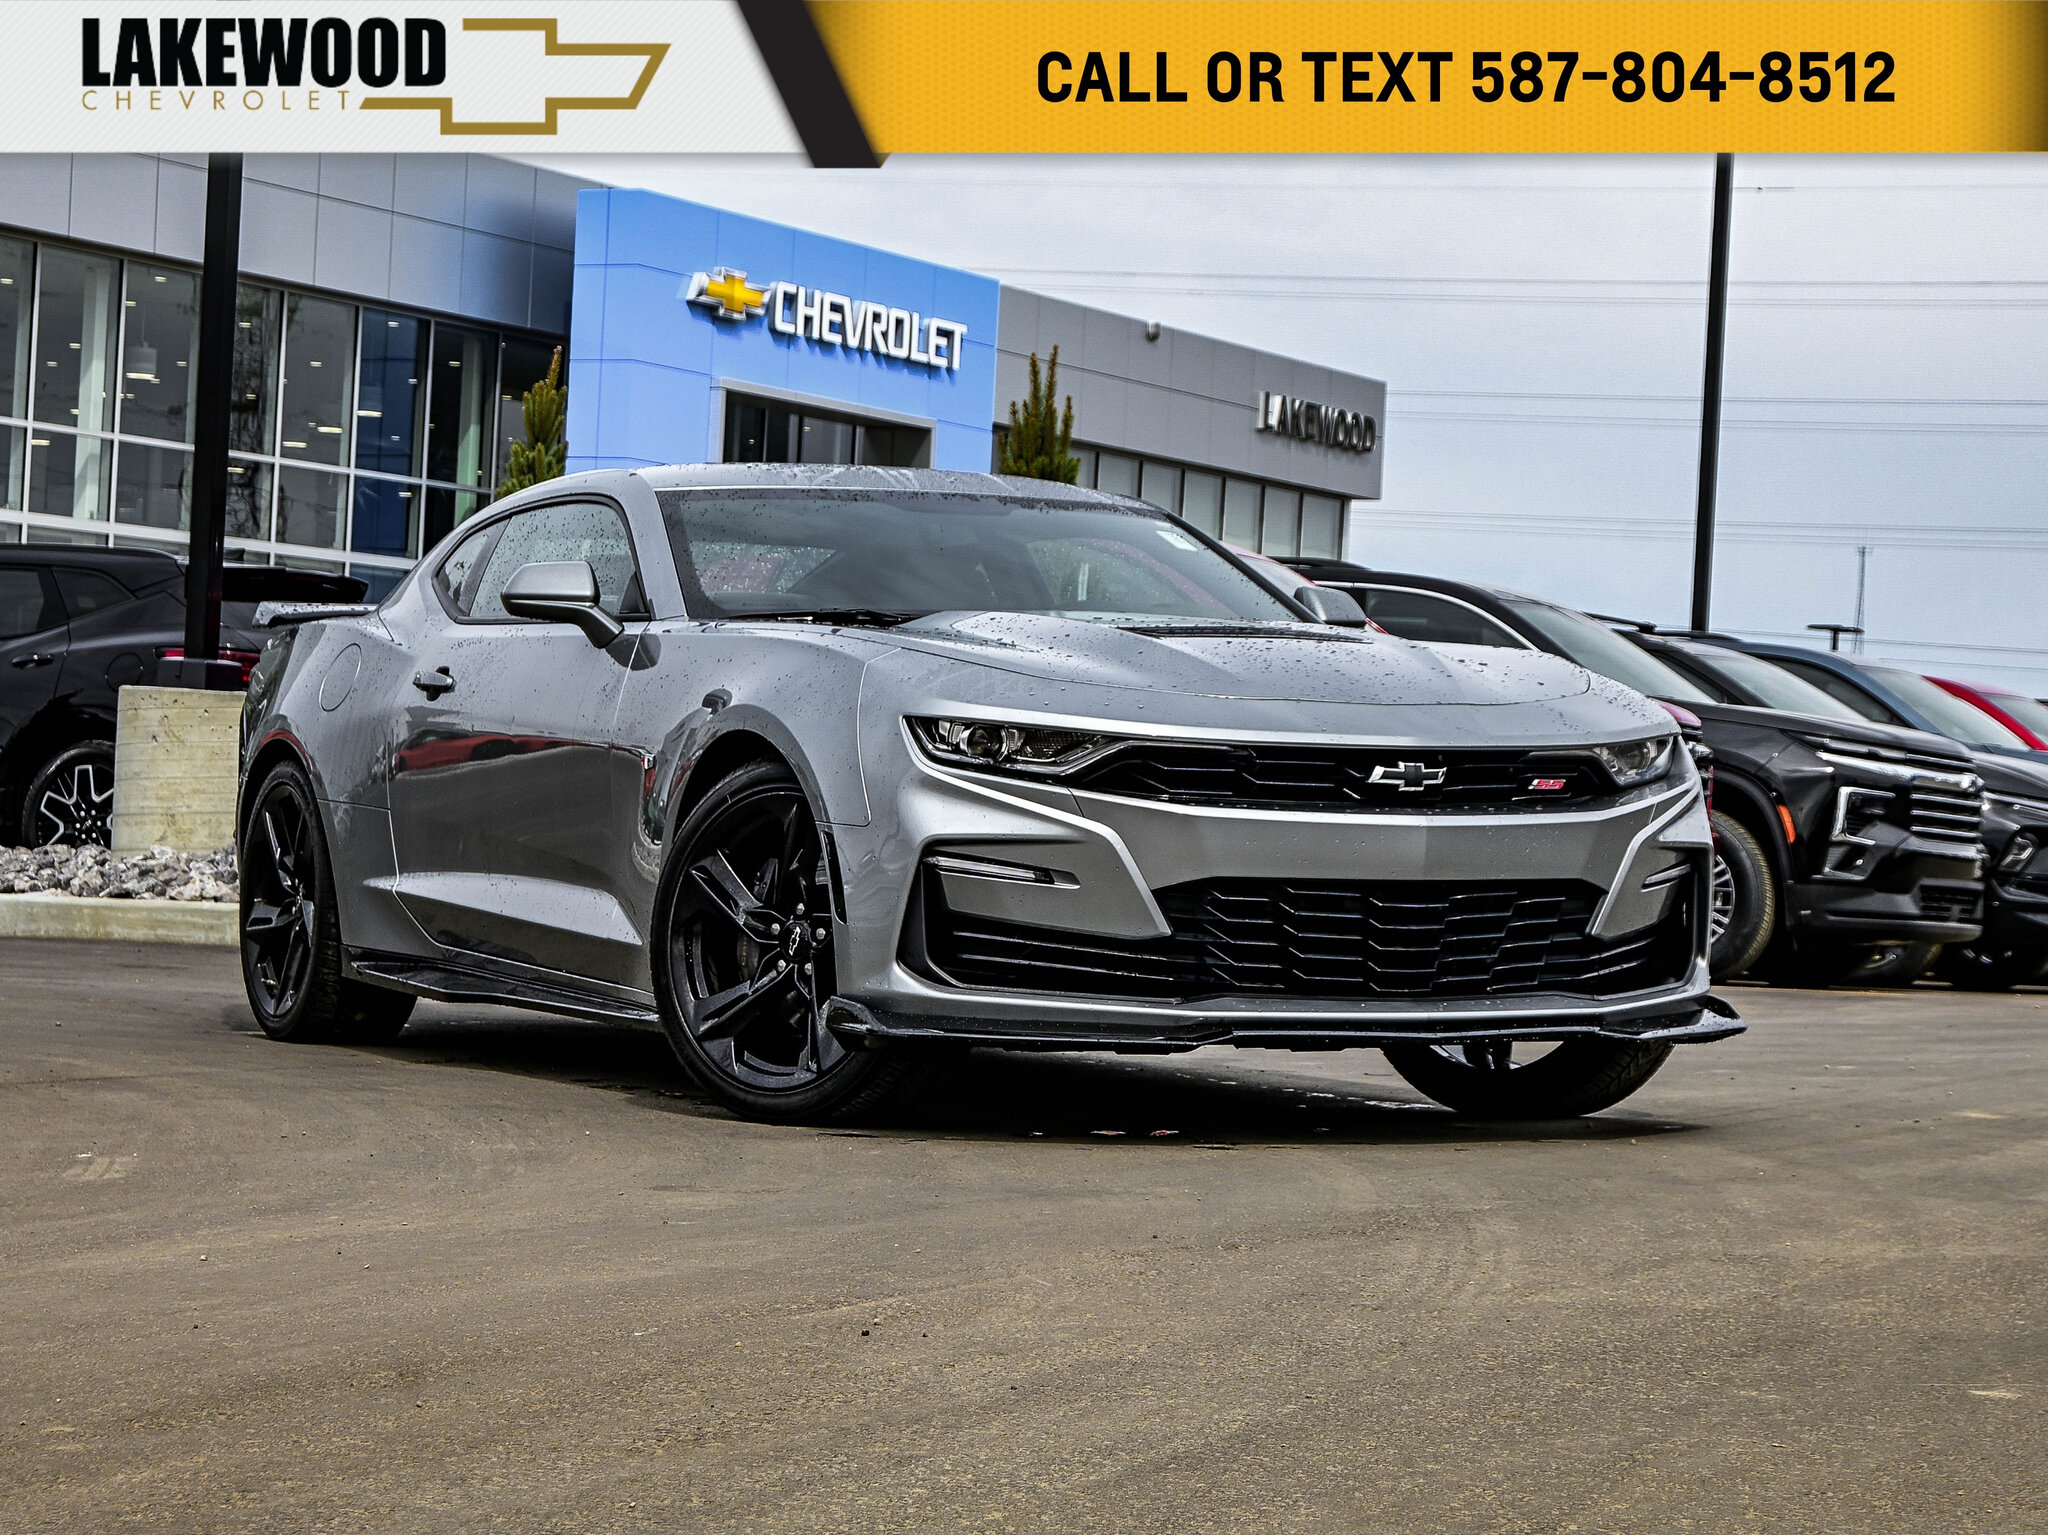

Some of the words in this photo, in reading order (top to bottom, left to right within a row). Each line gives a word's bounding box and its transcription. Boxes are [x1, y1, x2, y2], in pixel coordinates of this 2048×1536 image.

[772, 280, 968, 371] CHEVROLET
[1257, 391, 1376, 452] LAKEWOOD
[1528, 779, 1566, 790] SS
